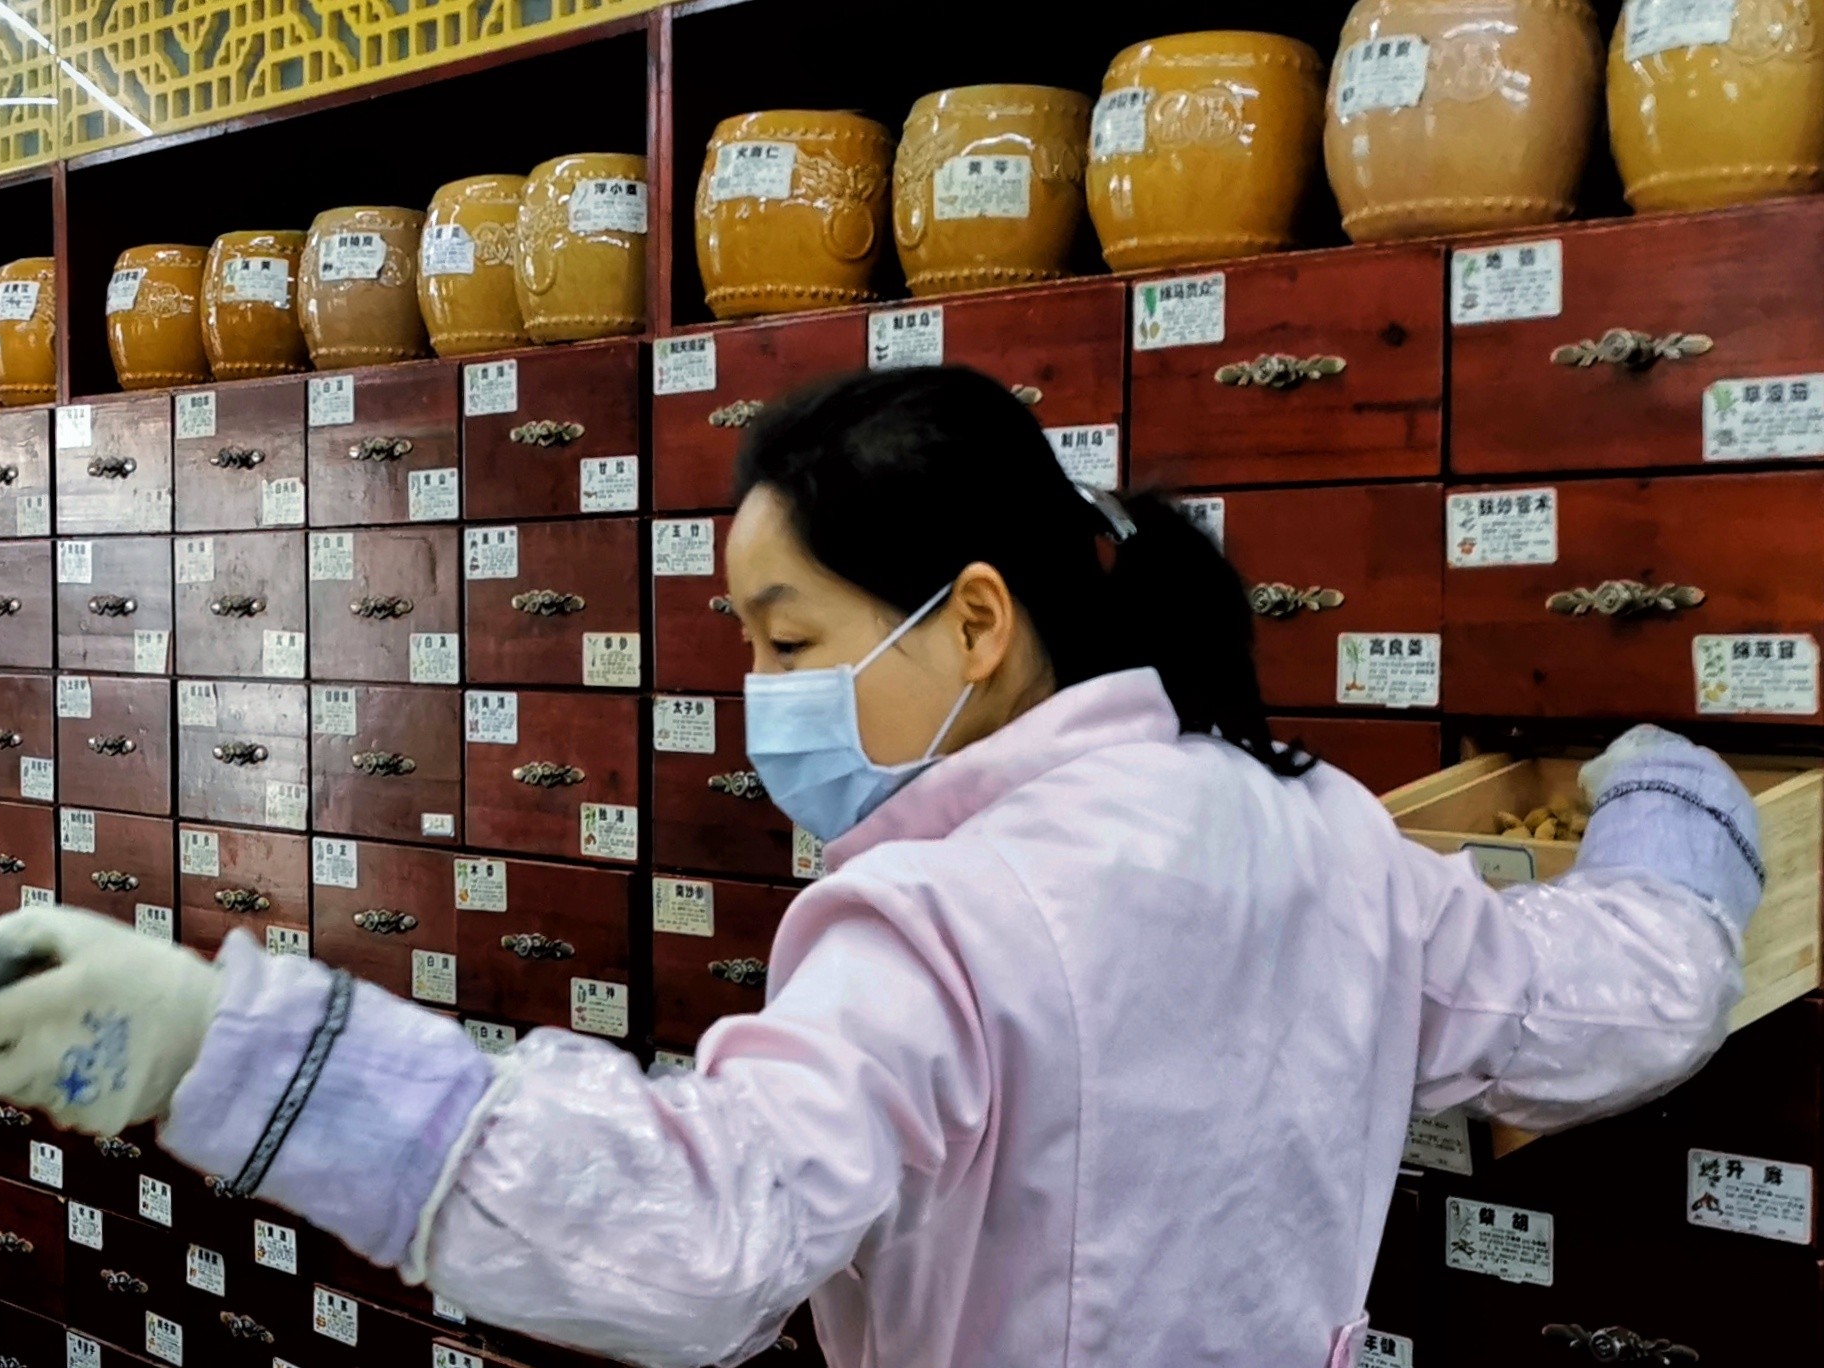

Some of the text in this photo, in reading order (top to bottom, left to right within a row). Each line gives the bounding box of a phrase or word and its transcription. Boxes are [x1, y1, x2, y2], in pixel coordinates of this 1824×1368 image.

[1061, 431, 1104, 448] 制川乌
[672, 524, 700, 538] 玉竹
[1369, 638, 1422, 656] 高良姜
[673, 701, 705, 715] 太子参
[470, 864, 494, 878] 木香
[1725, 1159, 1783, 1185] 升麻
[1479, 1207, 1529, 1233] 柴胡
[1364, 1330, 1396, 1357] 年健
